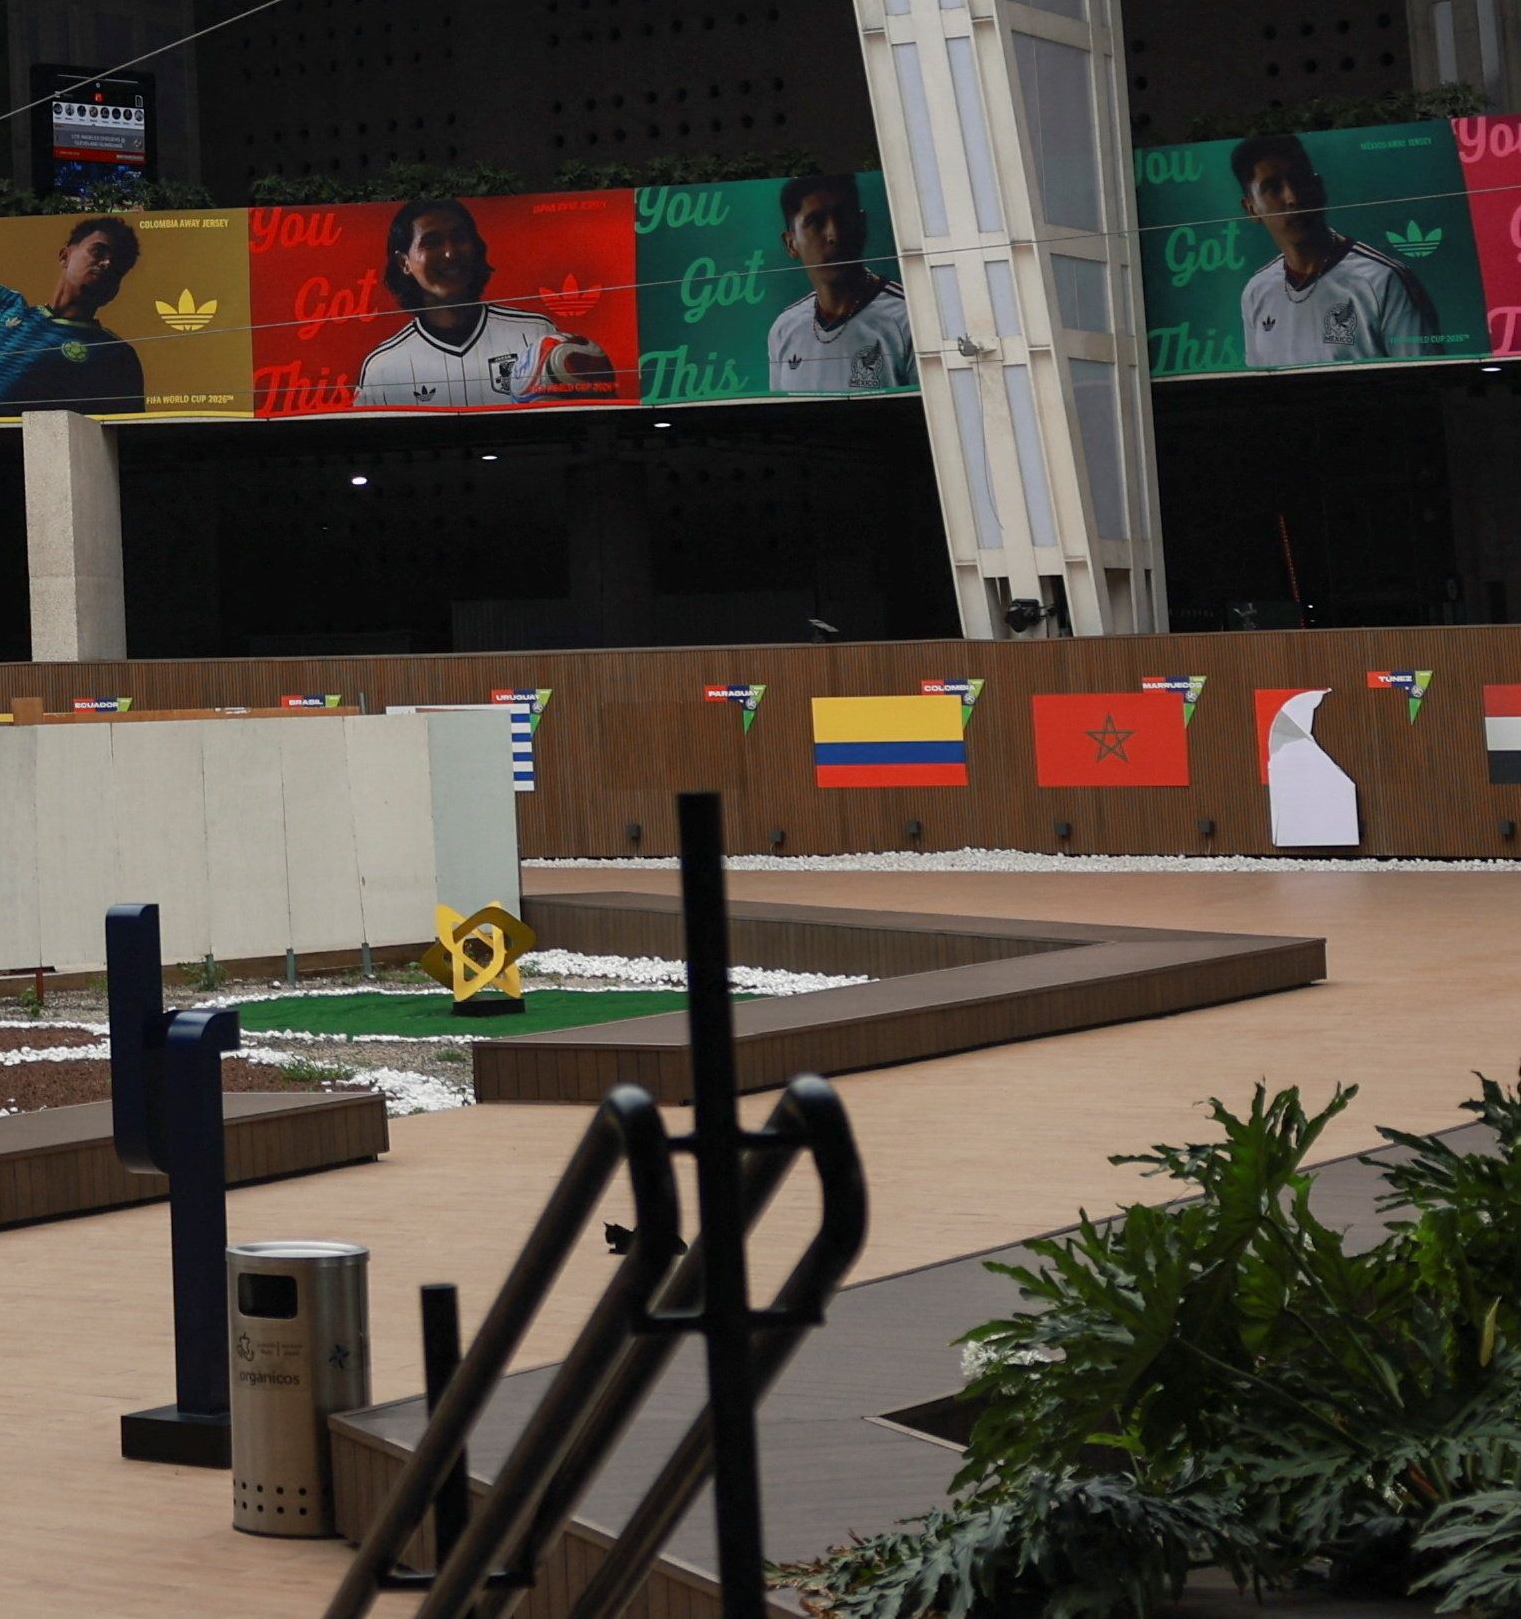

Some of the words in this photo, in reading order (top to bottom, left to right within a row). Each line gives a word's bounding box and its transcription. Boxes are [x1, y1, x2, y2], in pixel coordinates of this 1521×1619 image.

[1136, 149, 1203, 186] ou
[139, 219, 178, 229] COLOMBIA
[180, 219, 200, 228] AWAY
[202, 218, 229, 228] JERSEY
[249, 207, 343, 253] You
[635, 186, 730, 234] You
[1166, 221, 1245, 287] Got
[294, 268, 378, 340] Got
[680, 250, 765, 323] Got
[639, 345, 749, 400] This
[1149, 322, 1243, 374] This
[146, 396, 161, 405] FIFA
[162, 396, 189, 404] WORLD
[190, 395, 207, 404] CUP
[253, 360, 362, 417] This
[924, 684, 976, 692] COLOMBIA
